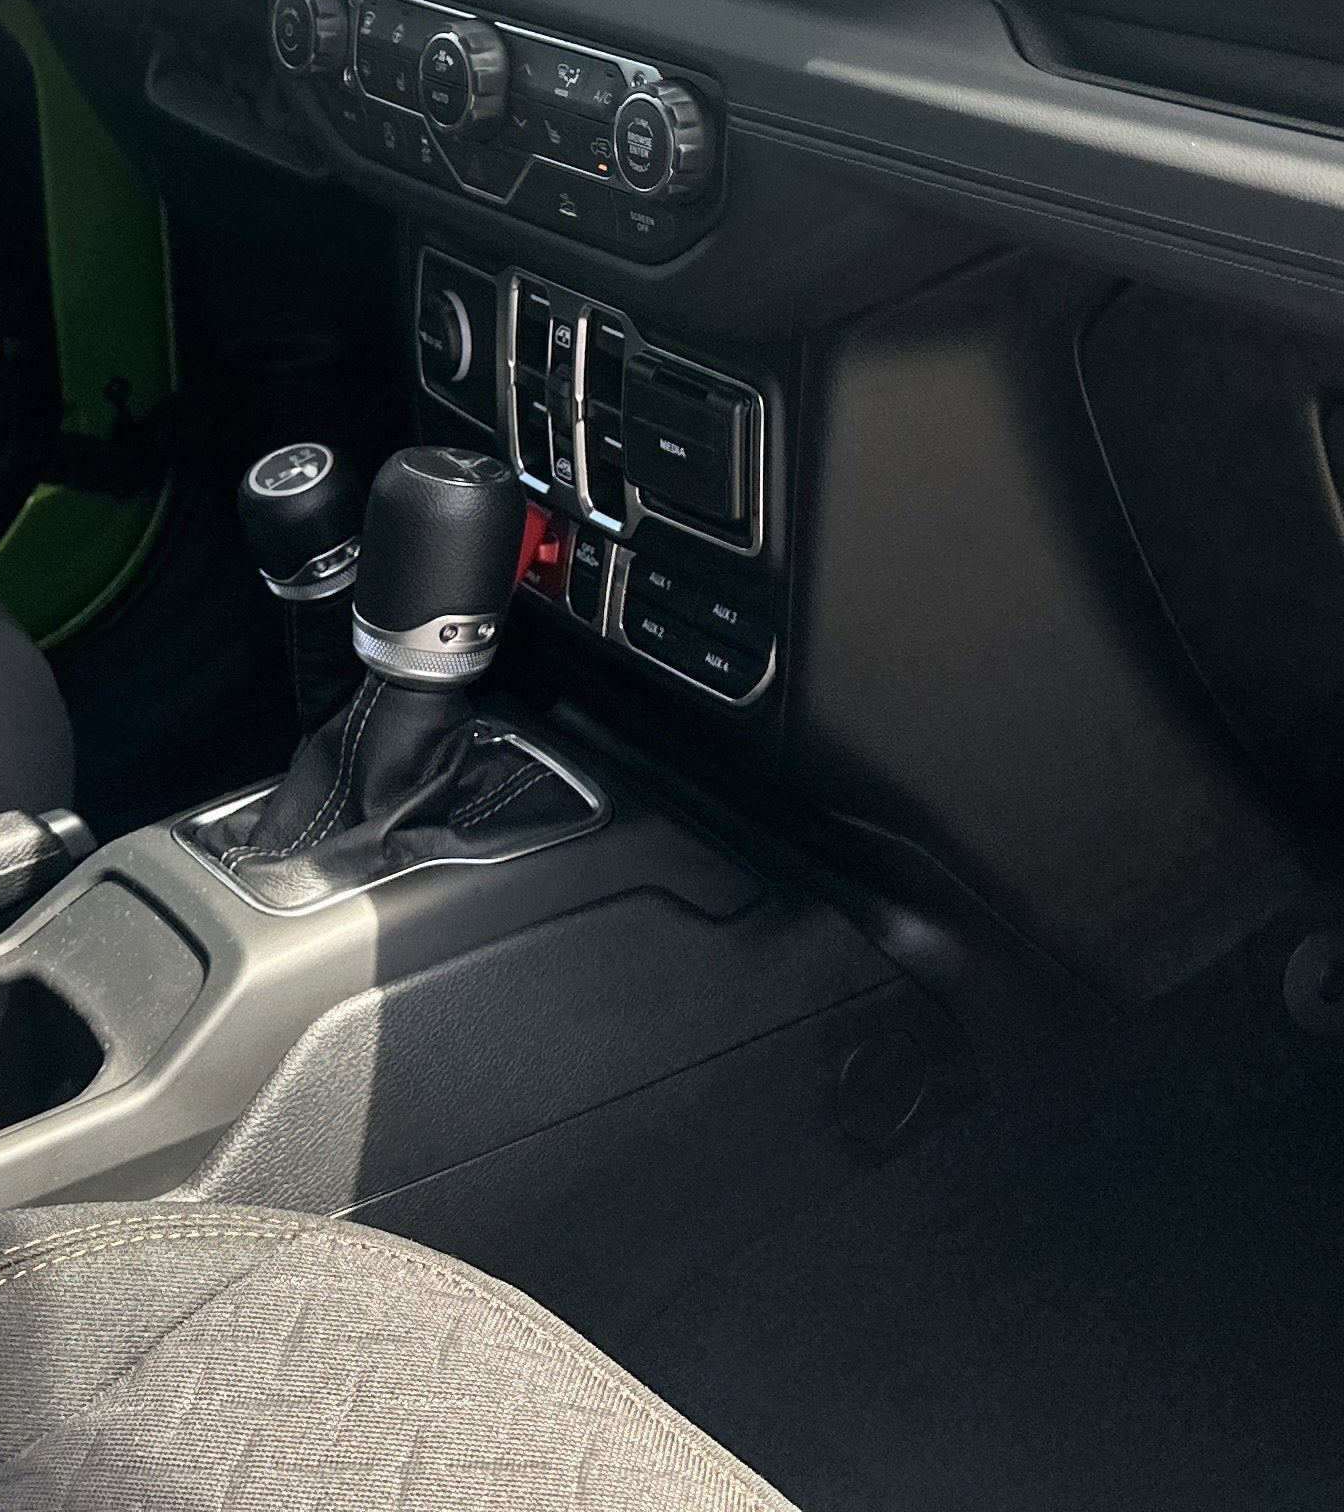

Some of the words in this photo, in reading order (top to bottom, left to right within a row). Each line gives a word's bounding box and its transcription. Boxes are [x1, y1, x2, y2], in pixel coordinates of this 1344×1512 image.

[593, 89, 613, 105] A/C
[659, 438, 686, 458] MEDIA
[649, 571, 666, 587] AUX
[712, 603, 731, 620] AUX
[641, 619, 658, 635] AUX
[705, 652, 723, 670] AUX
